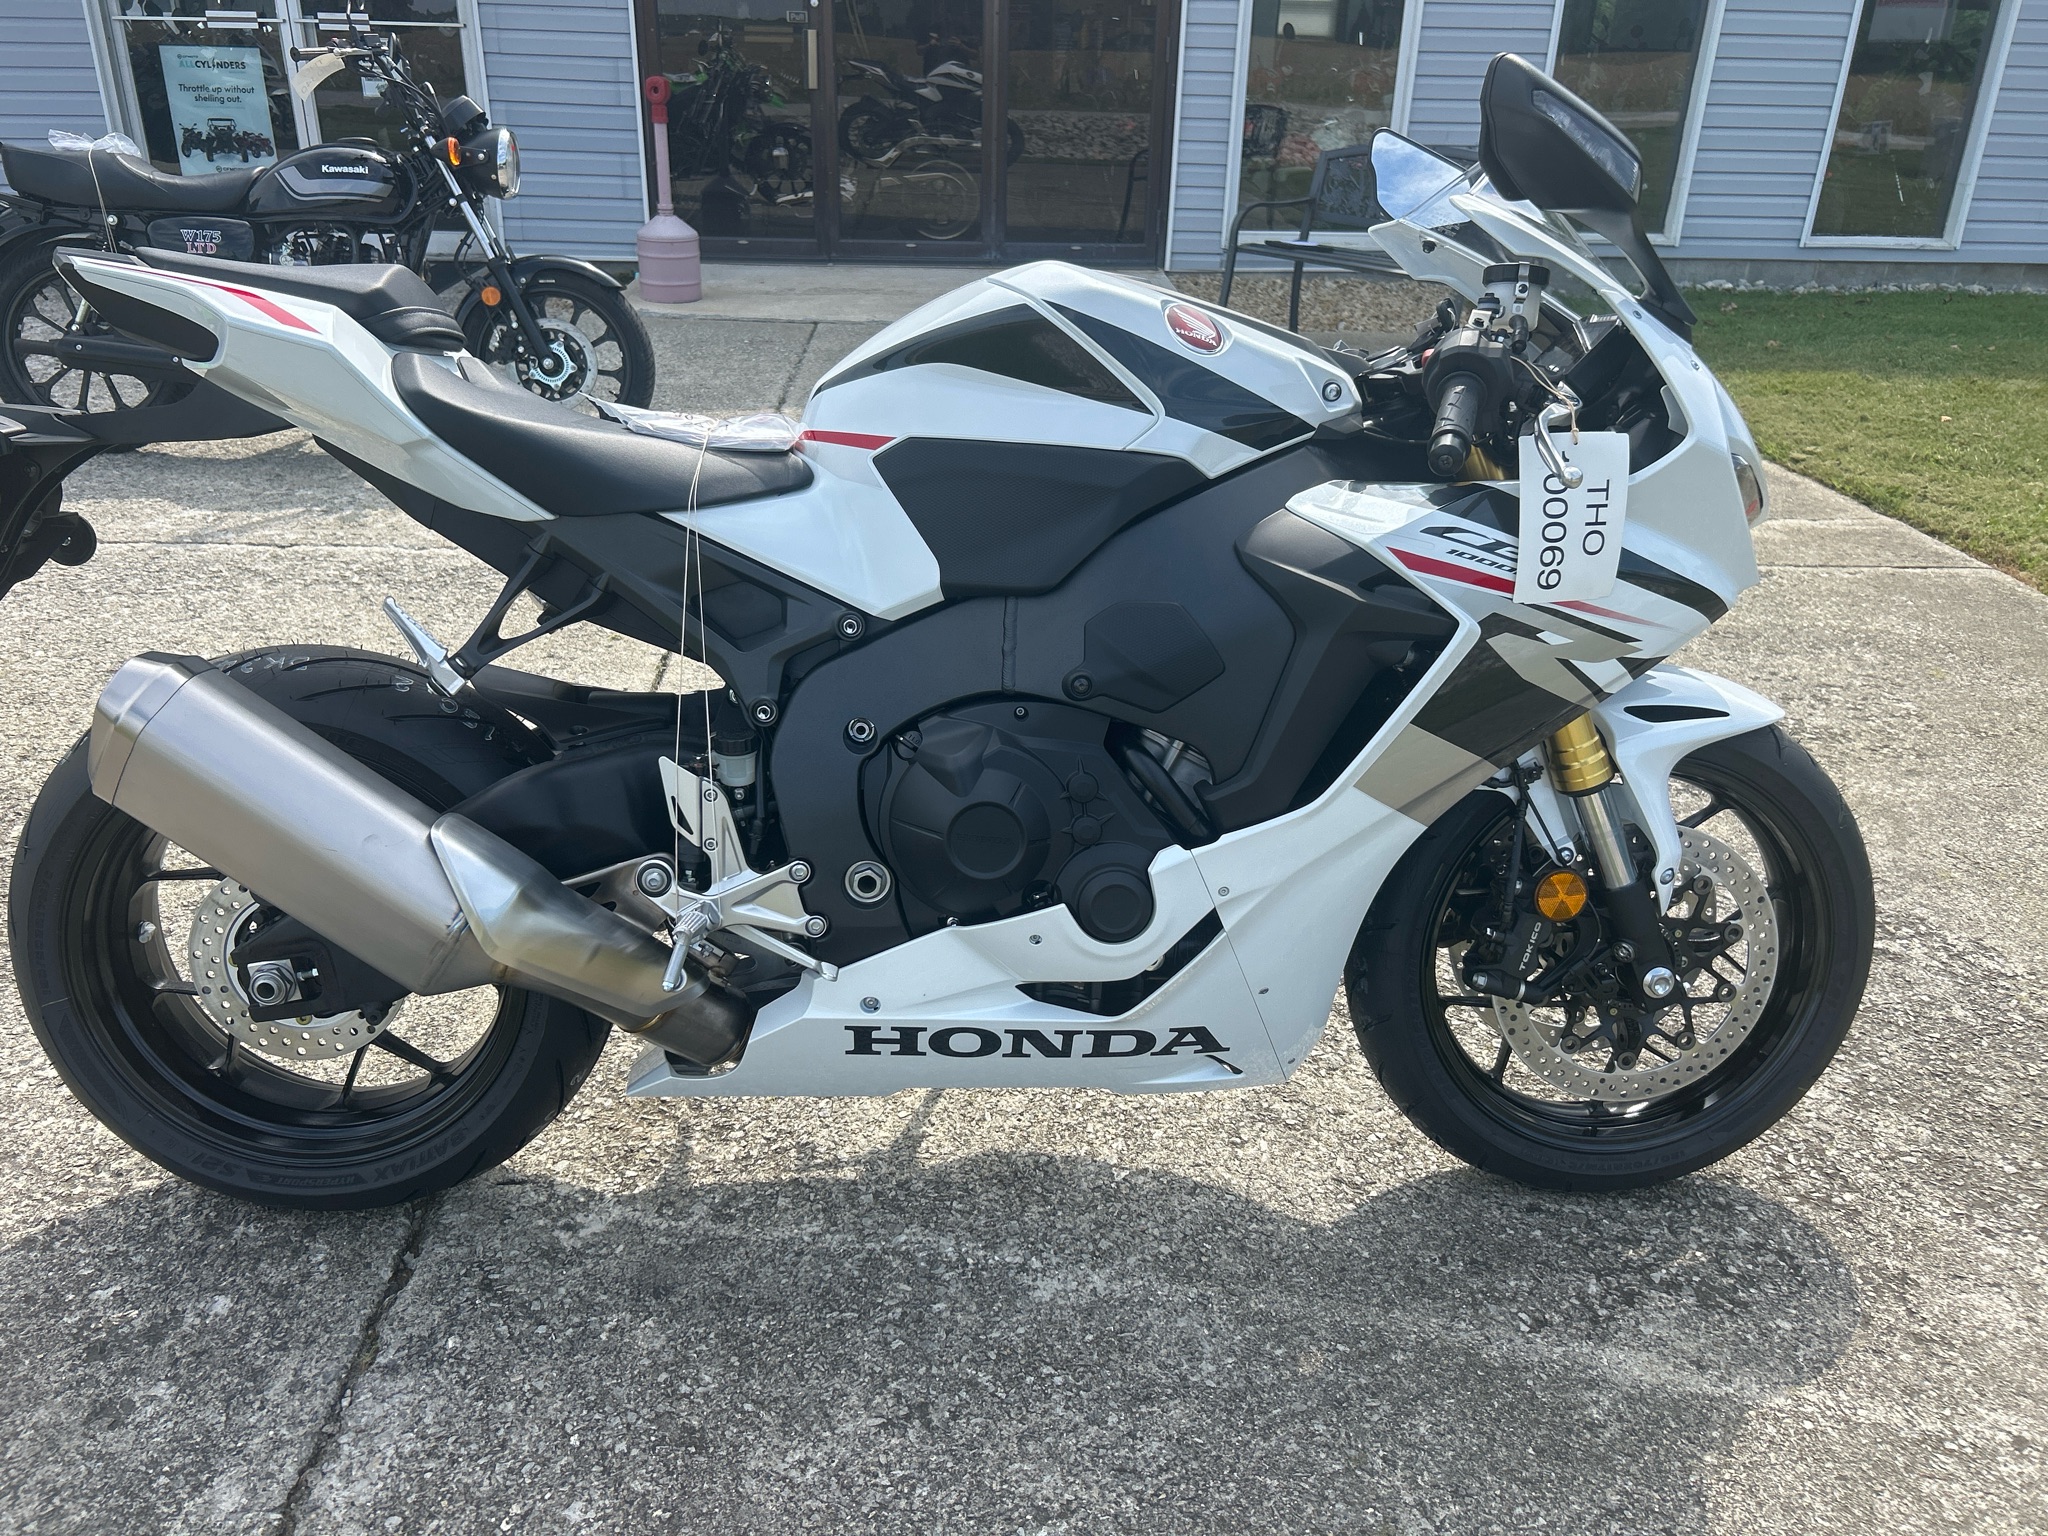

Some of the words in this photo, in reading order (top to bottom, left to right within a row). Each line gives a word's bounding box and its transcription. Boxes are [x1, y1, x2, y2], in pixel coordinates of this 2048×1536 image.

[178, 84, 210, 93] Throttle
[224, 85, 254, 94] without
[194, 94, 225, 104] shelling
[321, 165, 369, 174] Kawasaki
[180, 229, 222, 243] W175
[186, 242, 217, 254] LTD
[1175, 328, 1217, 347] HONDA
[1582, 479, 1610, 556] THO
[1446, 548, 1518, 575] 1000
[1519, 921, 1542, 971] TOKICO
[844, 1025, 1231, 1058] HONDA
